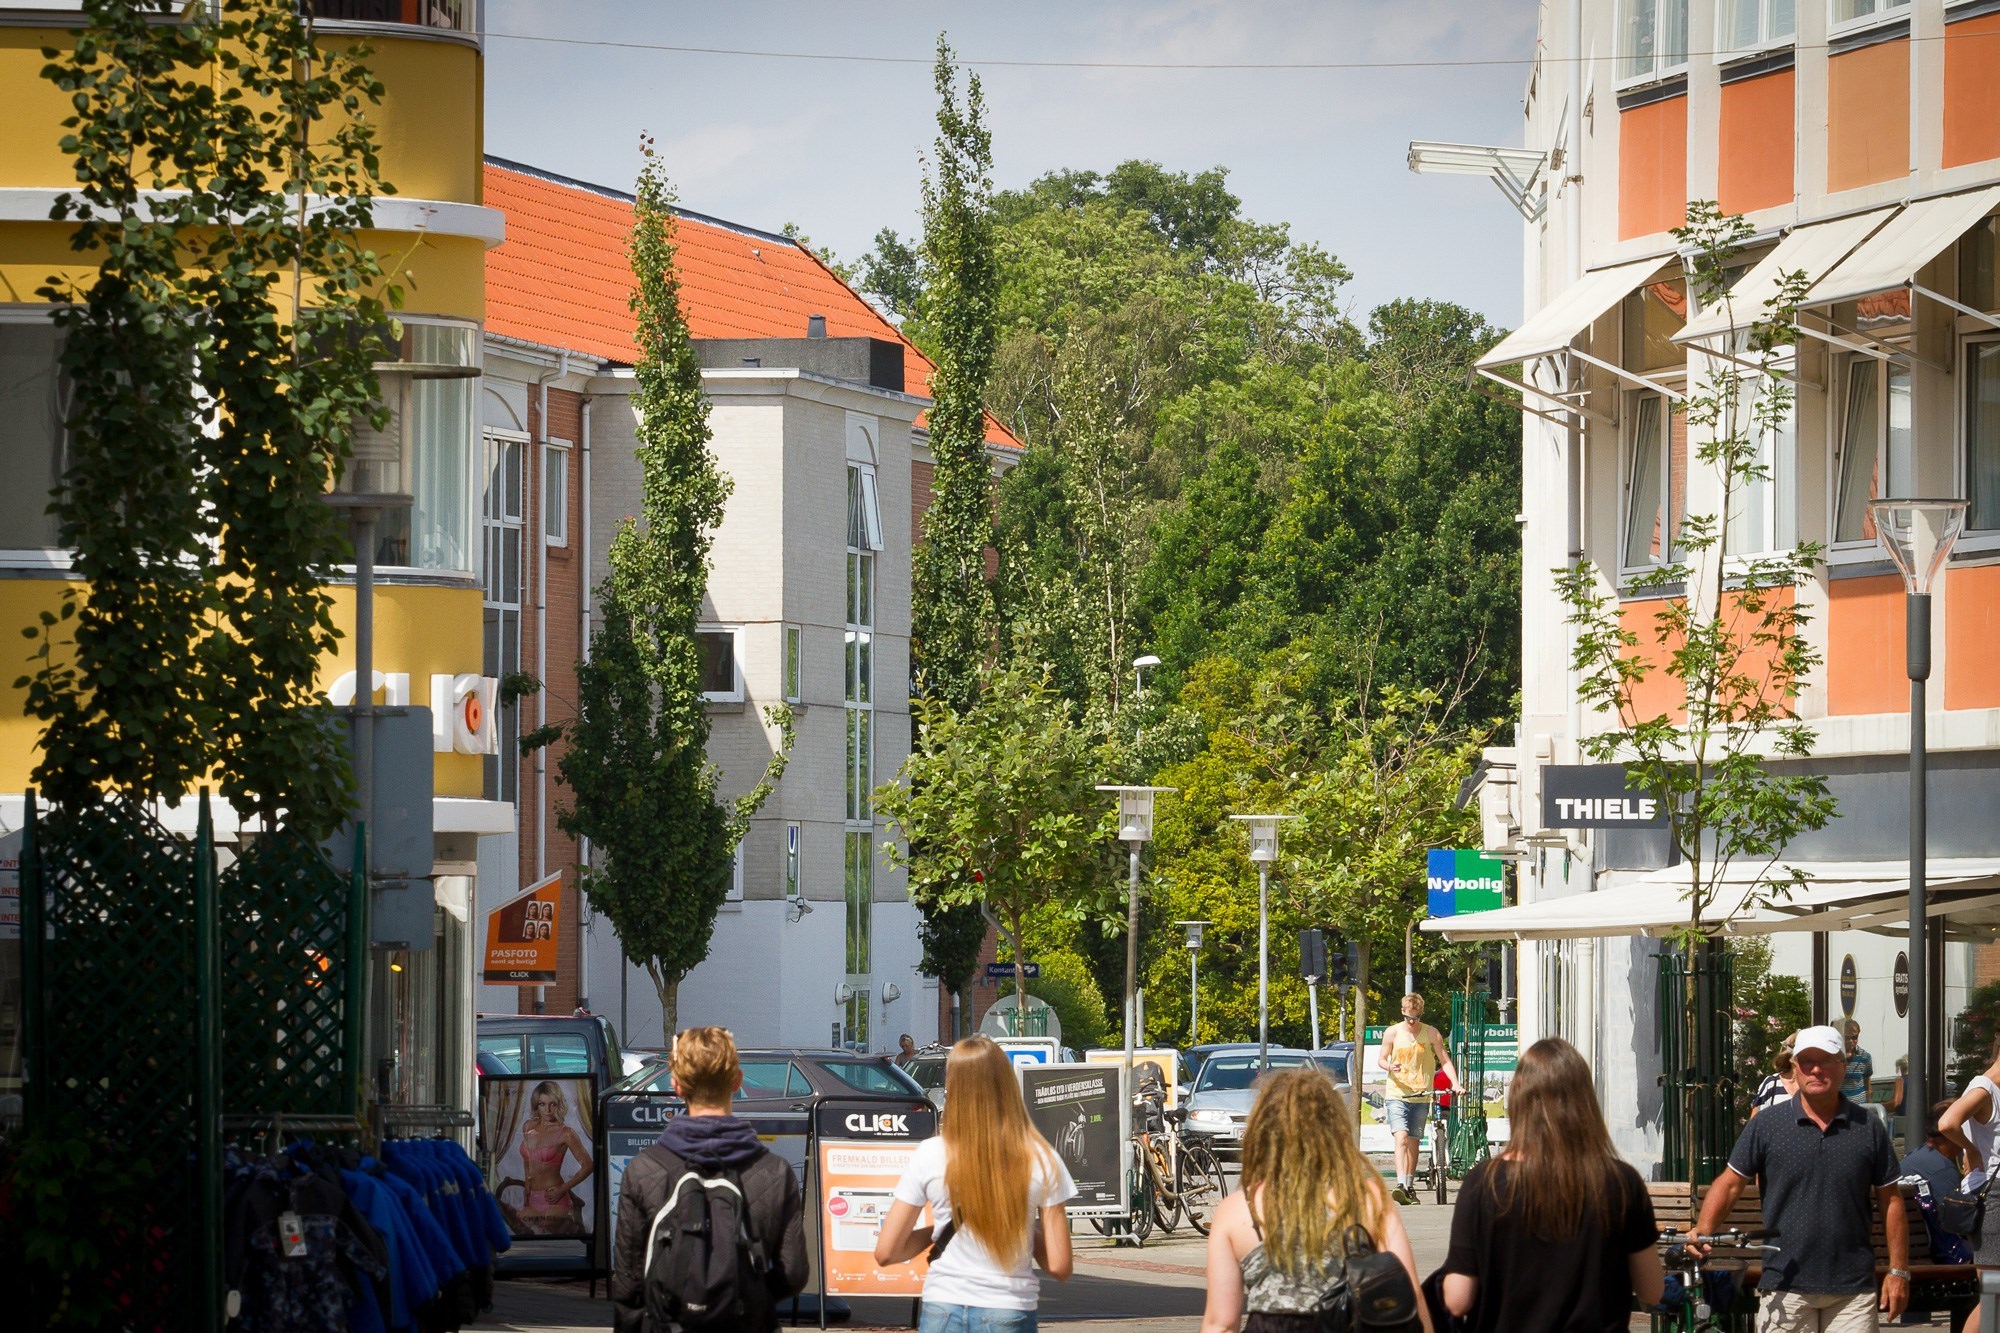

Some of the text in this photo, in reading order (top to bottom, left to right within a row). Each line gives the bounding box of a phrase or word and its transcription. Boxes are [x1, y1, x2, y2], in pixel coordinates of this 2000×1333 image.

[1555, 798, 1657, 820] THIELE
[1427, 877, 1503, 893] Nybolig
[491, 949, 538, 958] PASFOTO
[845, 1113, 910, 1132] CLICK
[832, 1154, 911, 1164] FREMKALD BILLED
